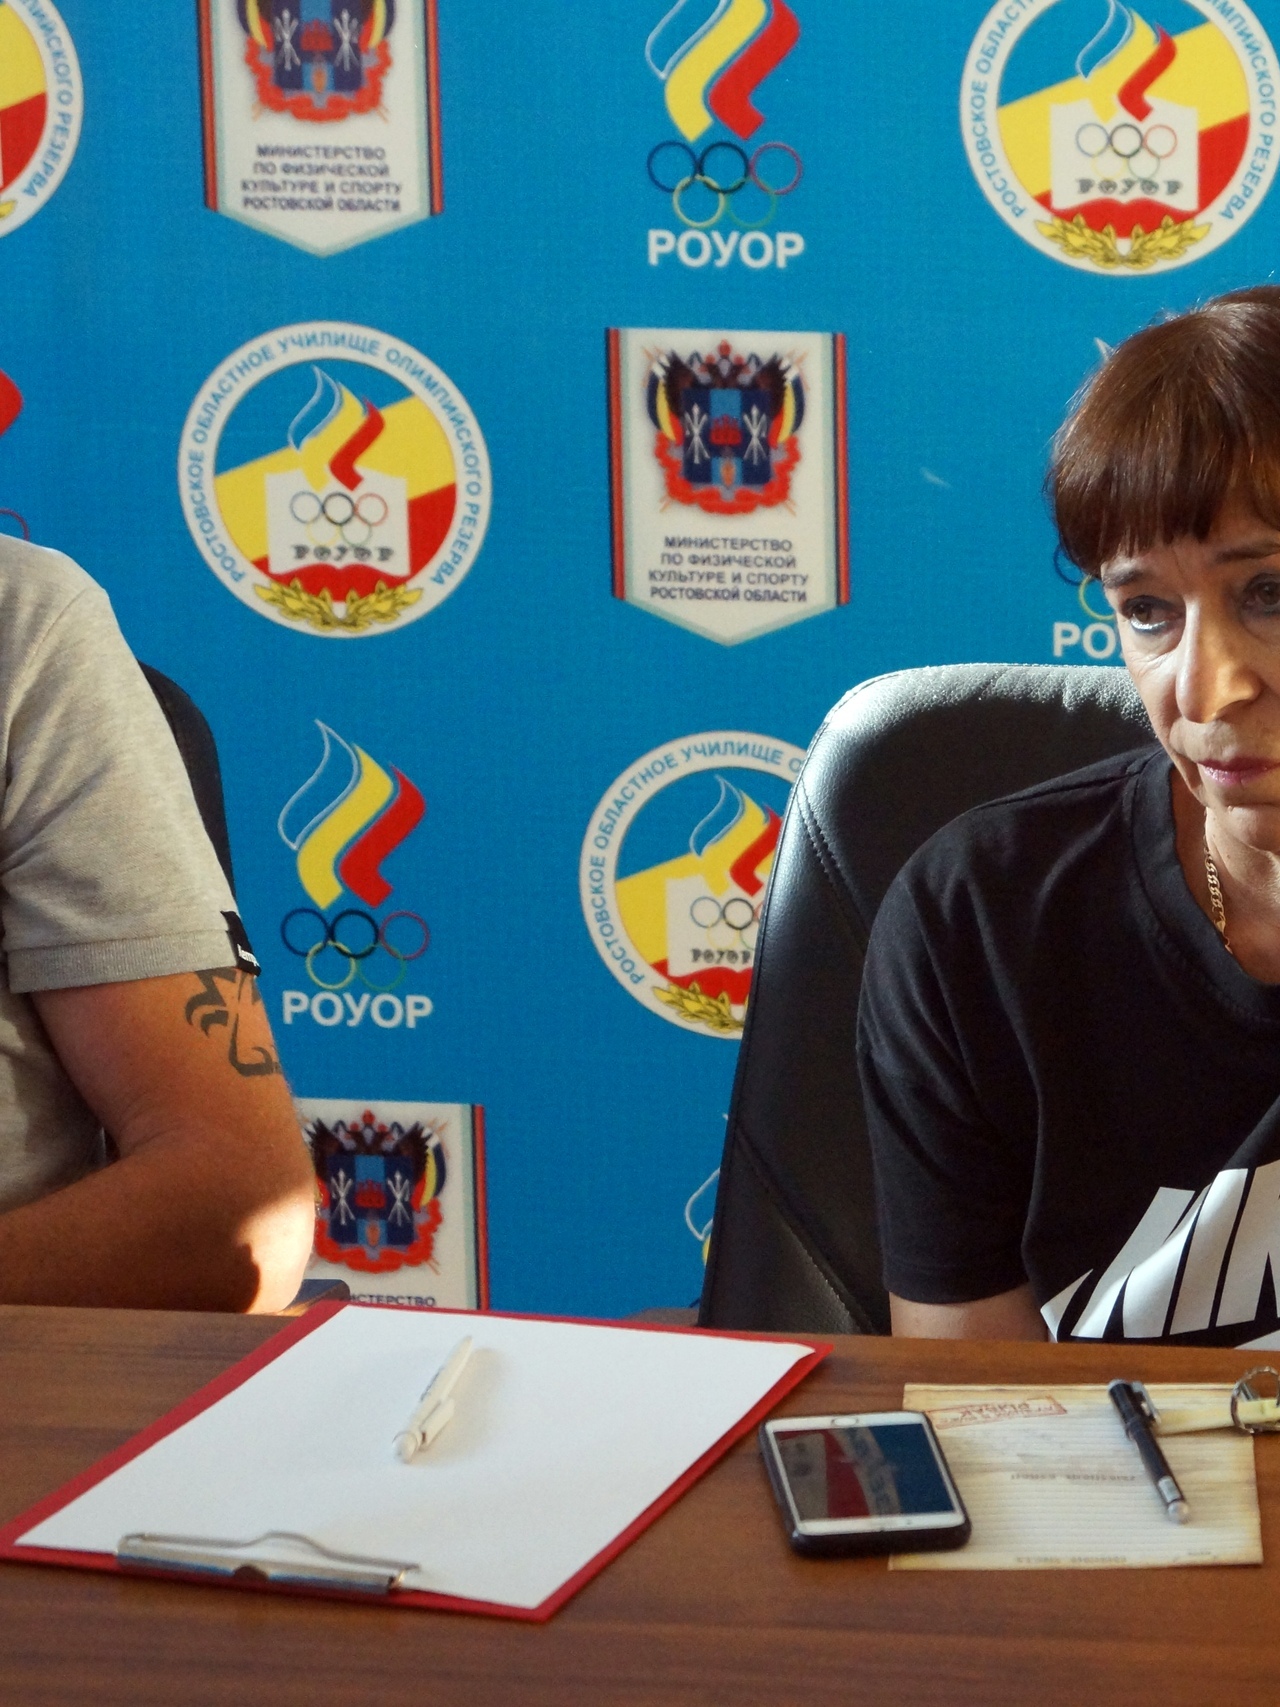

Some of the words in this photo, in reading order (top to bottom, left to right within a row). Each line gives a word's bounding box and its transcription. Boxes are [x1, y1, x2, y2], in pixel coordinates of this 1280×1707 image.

[22, 112, 73, 197] РЕЗЕРВА
[257, 145, 386, 160] МИНИСТЕРСТВО
[970, 80, 1026, 219] РОСТОВСКОЕ
[1219, 133, 1274, 222] РЕЗЕРВА
[253, 162, 276, 175] ПО
[281, 162, 389, 177] ФИЗИЧЕСКОЙ
[241, 180, 319, 194] КУЛЬТУРЕ
[325, 182, 335, 193] И
[340, 181, 402, 195] СПОРТУ
[243, 196, 334, 211] РОСТОВСКОЙ
[338, 199, 400, 212] ОБЛАСТИ
[648, 229, 805, 269] РОУОР
[278, 331, 380, 355] УЧИЛИЩЕ
[192, 347, 275, 443] ОБЛАСТНОЕ
[386, 348, 482, 498] ОЛИМПИЙСКОГО
[188, 449, 246, 583] РОСТОВСКОЕ
[430, 502, 480, 586] РЕЗЕРВА
[664, 536, 792, 551] МИНИСТЕРСТВО
[661, 553, 684, 566] ПО
[688, 553, 796, 568] ФИЗИЧЕСКОЙ
[648, 570, 725, 584] КУЛЬТУРЕ
[732, 572, 742, 584] И
[746, 572, 809, 586] СПОРТУ
[650, 586, 740, 601] РОСТОВСКОЙ
[744, 588, 807, 602] ОБЛАСТИ
[681, 740, 783, 765] УЧИЛИЩЕ
[593, 754, 678, 849] ОБЛАСТНОЕ
[589, 854, 646, 984] РОСТОВСКОЕ
[282, 990, 433, 1029] РОУОР
